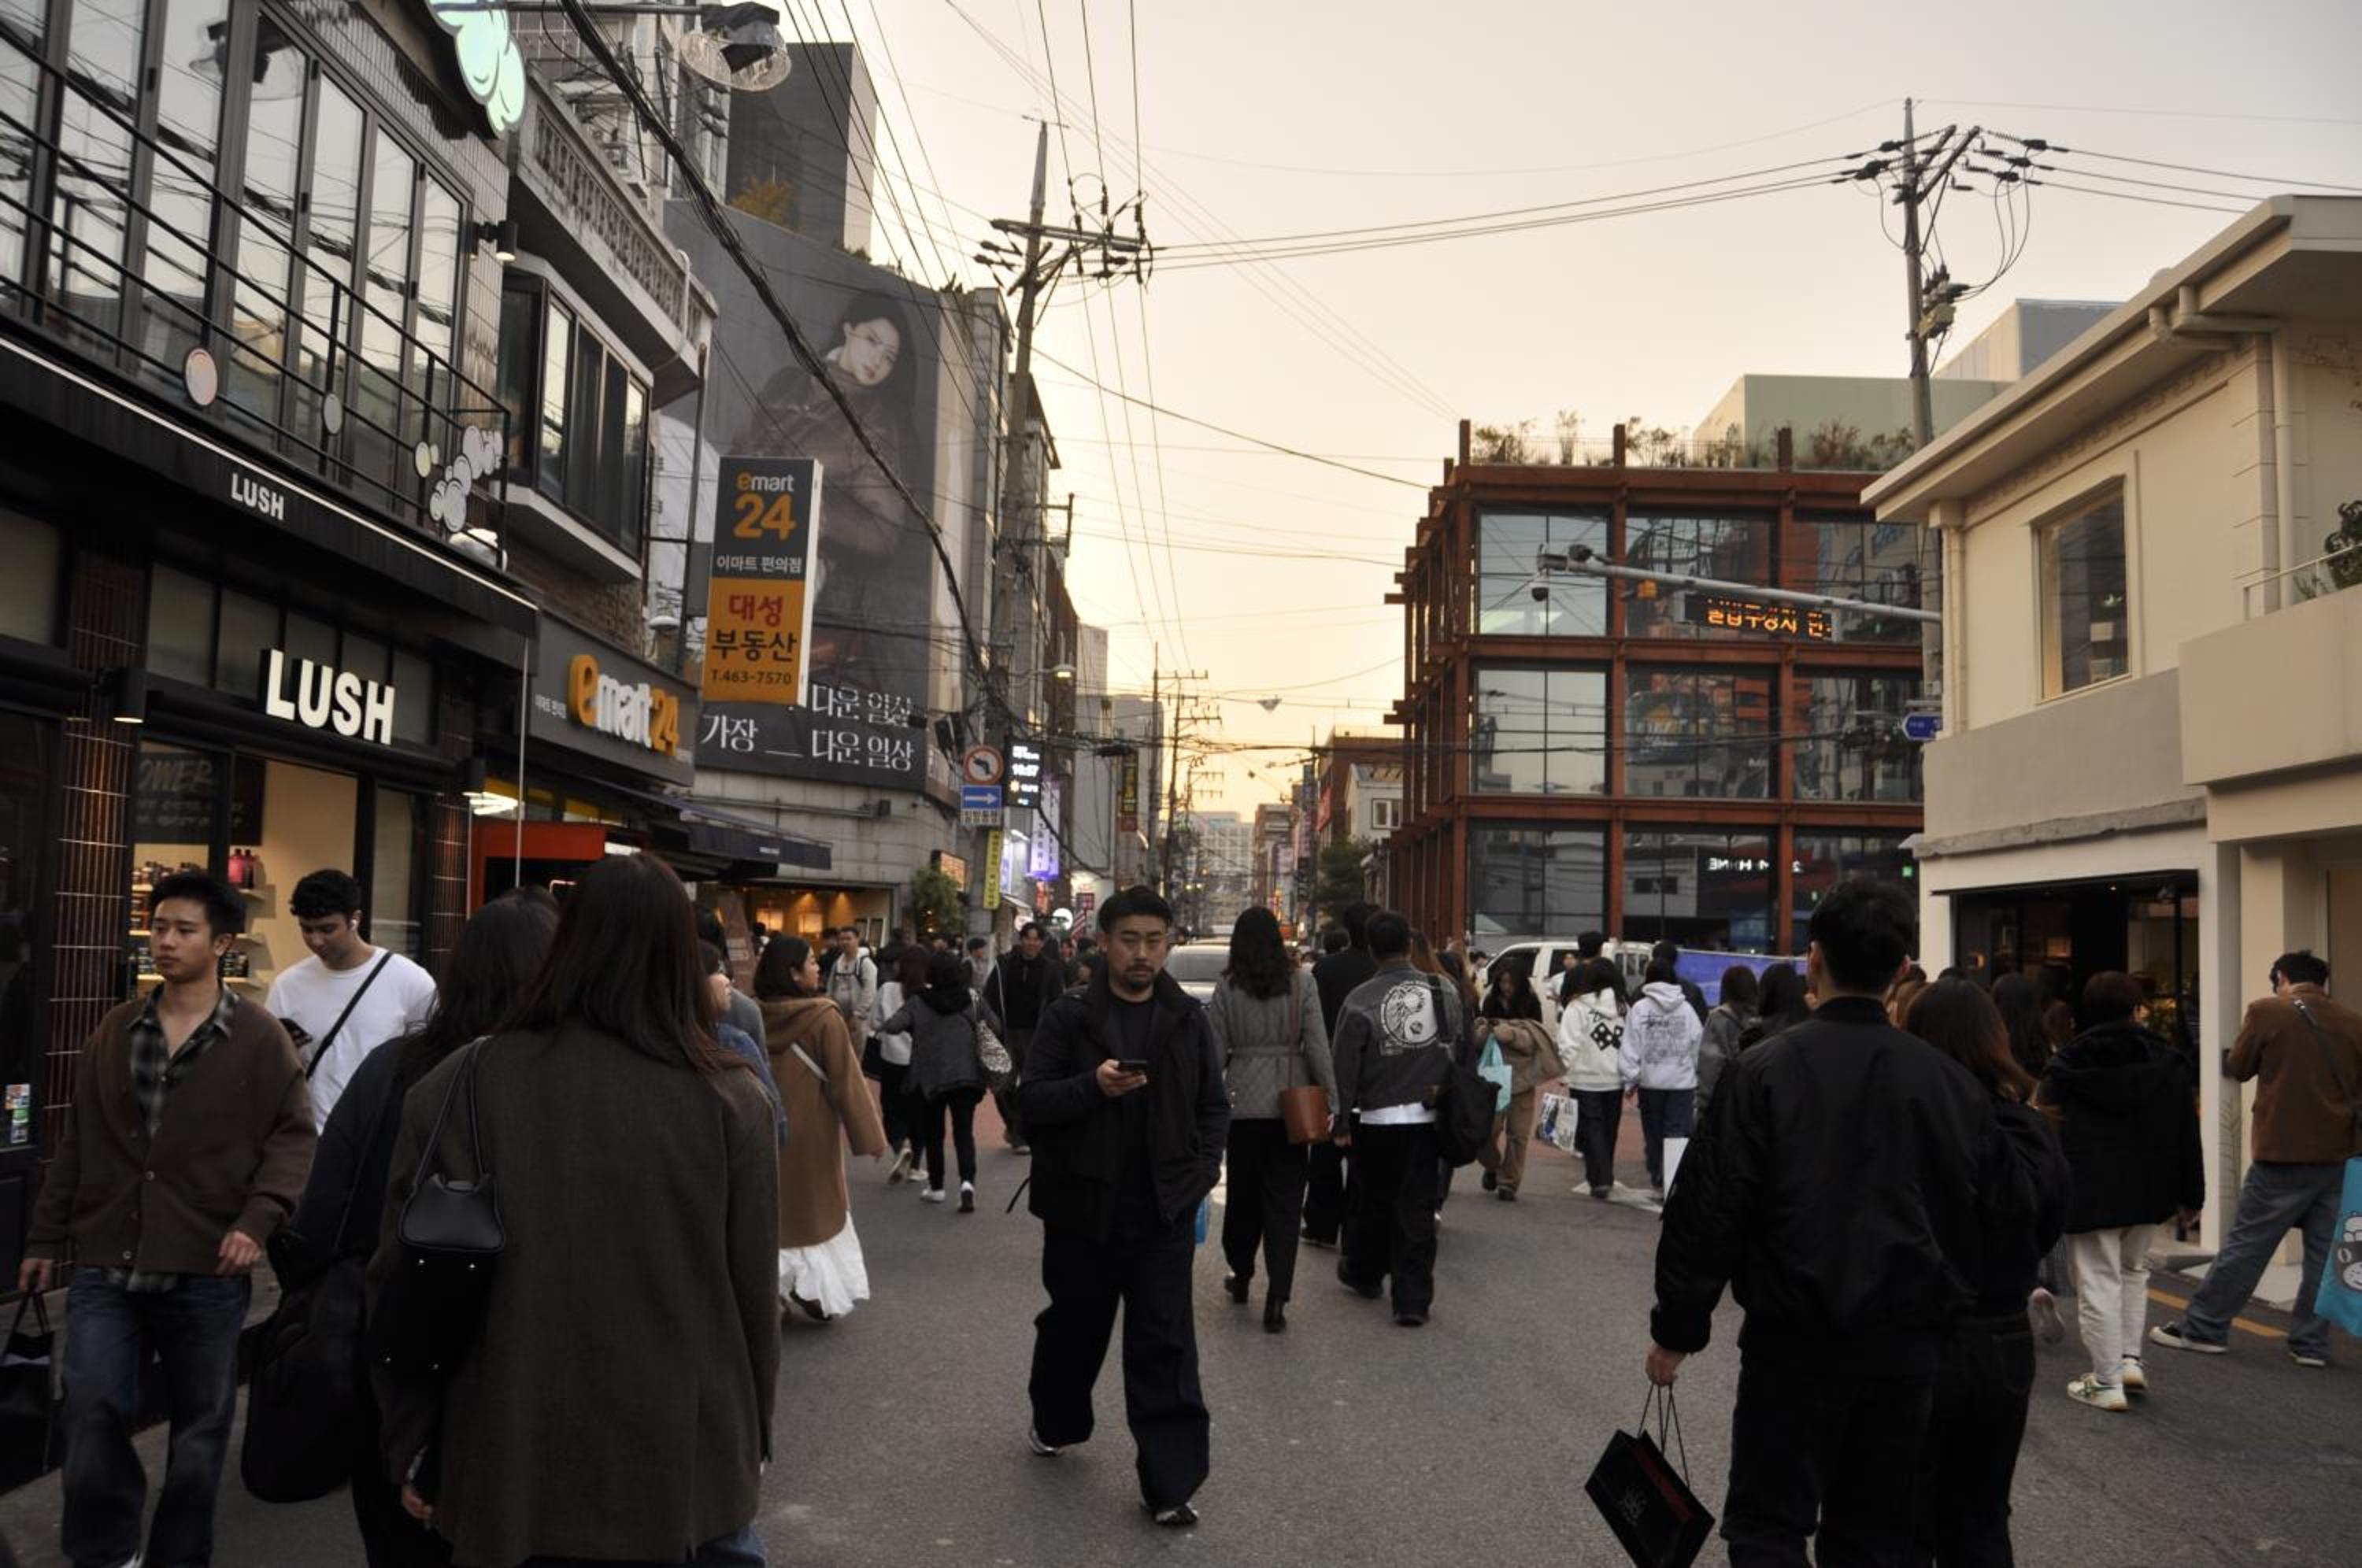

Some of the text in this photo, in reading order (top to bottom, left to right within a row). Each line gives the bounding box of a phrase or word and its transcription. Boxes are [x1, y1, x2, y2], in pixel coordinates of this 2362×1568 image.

[231, 472, 285, 521] LUSH
[736, 472, 794, 492] emart
[734, 493, 797, 540] 24
[717, 555, 802, 573] 이마트 편의점
[730, 595, 783, 627] 대성
[712, 630, 797, 662] 부동산
[712, 670, 792, 686] T.463-7570
[265, 649, 396, 745] LUSH
[701, 714, 758, 752] 가장
[812, 730, 860, 765] 다운
[867, 736, 914, 771] 일상
